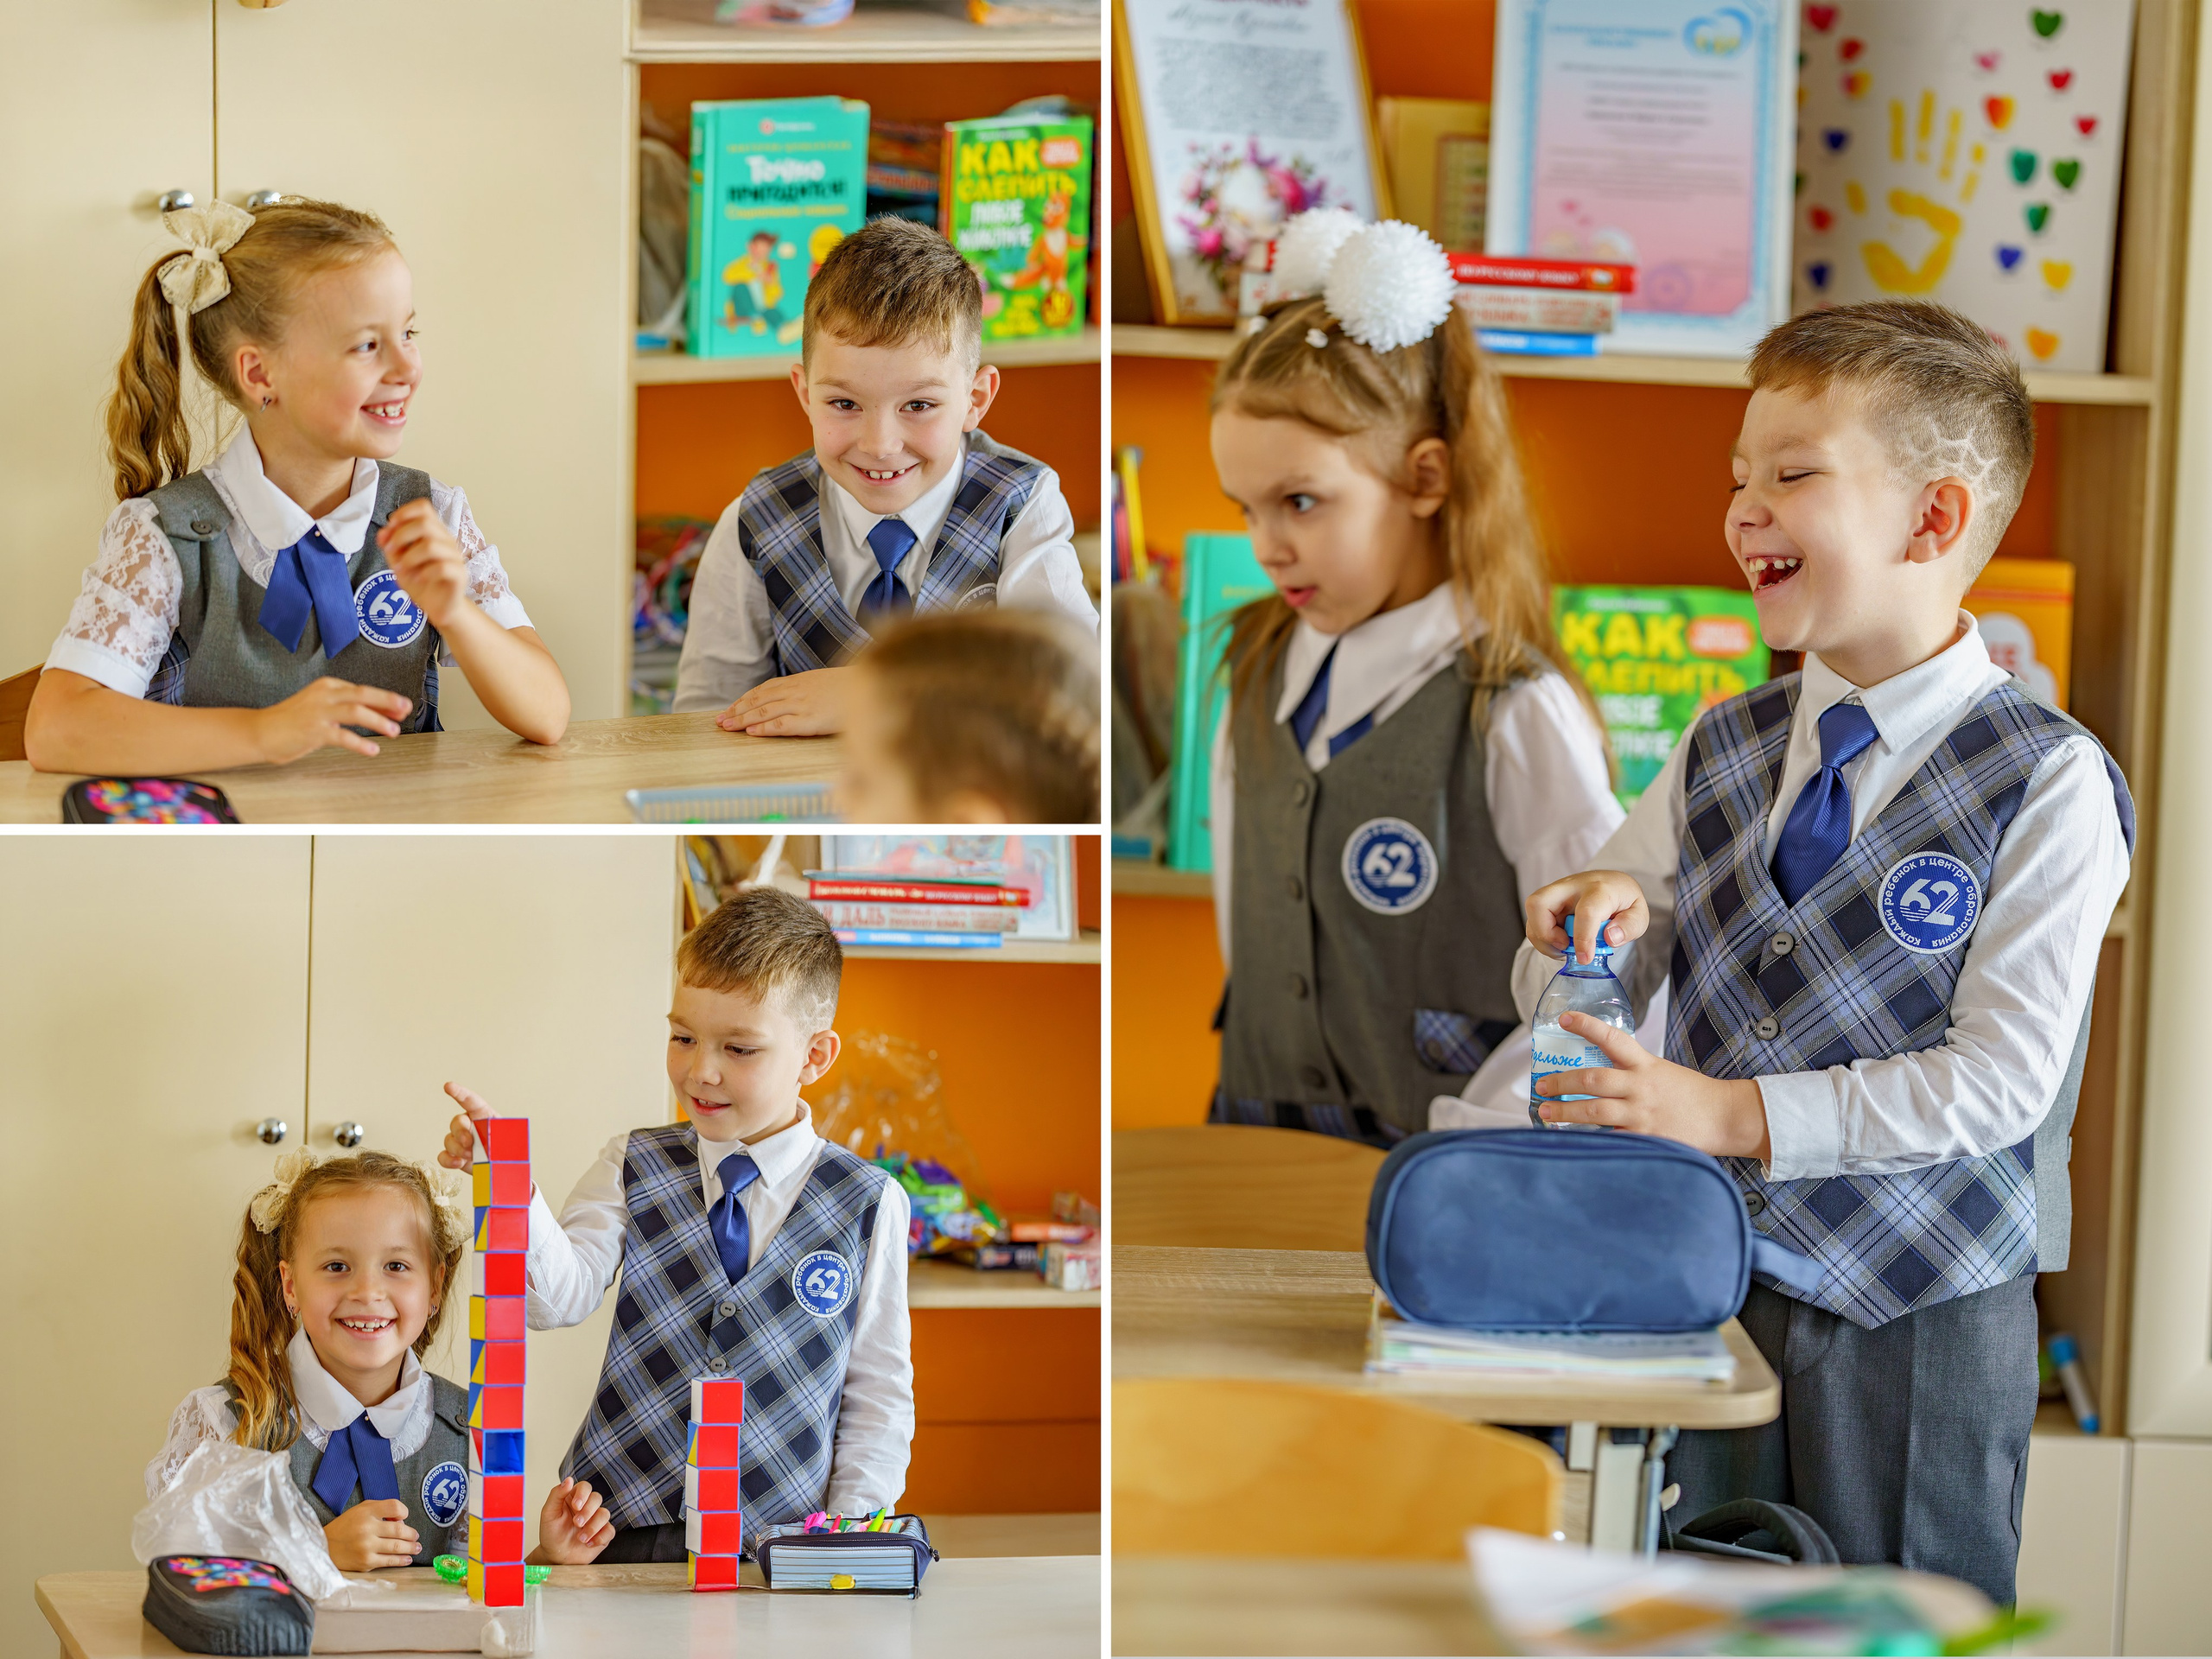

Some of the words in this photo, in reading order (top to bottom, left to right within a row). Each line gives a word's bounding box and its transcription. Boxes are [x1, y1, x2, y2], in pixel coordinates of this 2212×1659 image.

[961, 138, 1040, 176] КАК
[957, 170, 1077, 203] СЛЕПИТЬ
[357, 580, 378, 618] ребенок
[369, 589, 412, 626] 62
[1561, 612, 1686, 660] КАК
[1362, 841, 1416, 888] 62
[1919, 858, 1926, 867] в
[1929, 858, 1968, 883] центре
[1884, 861, 1917, 906] ребенок
[1899, 879, 1960, 926] 62
[1931, 886, 1977, 948] образования
[1884, 909, 1922, 946] каждый
[795, 1256, 816, 1287] ребенок
[823, 1255, 847, 1272] центре
[796, 1286, 820, 1313] каждый
[805, 1268, 841, 1300] 62
[825, 1273, 850, 1313] образования
[432, 1478, 460, 1510] 62
